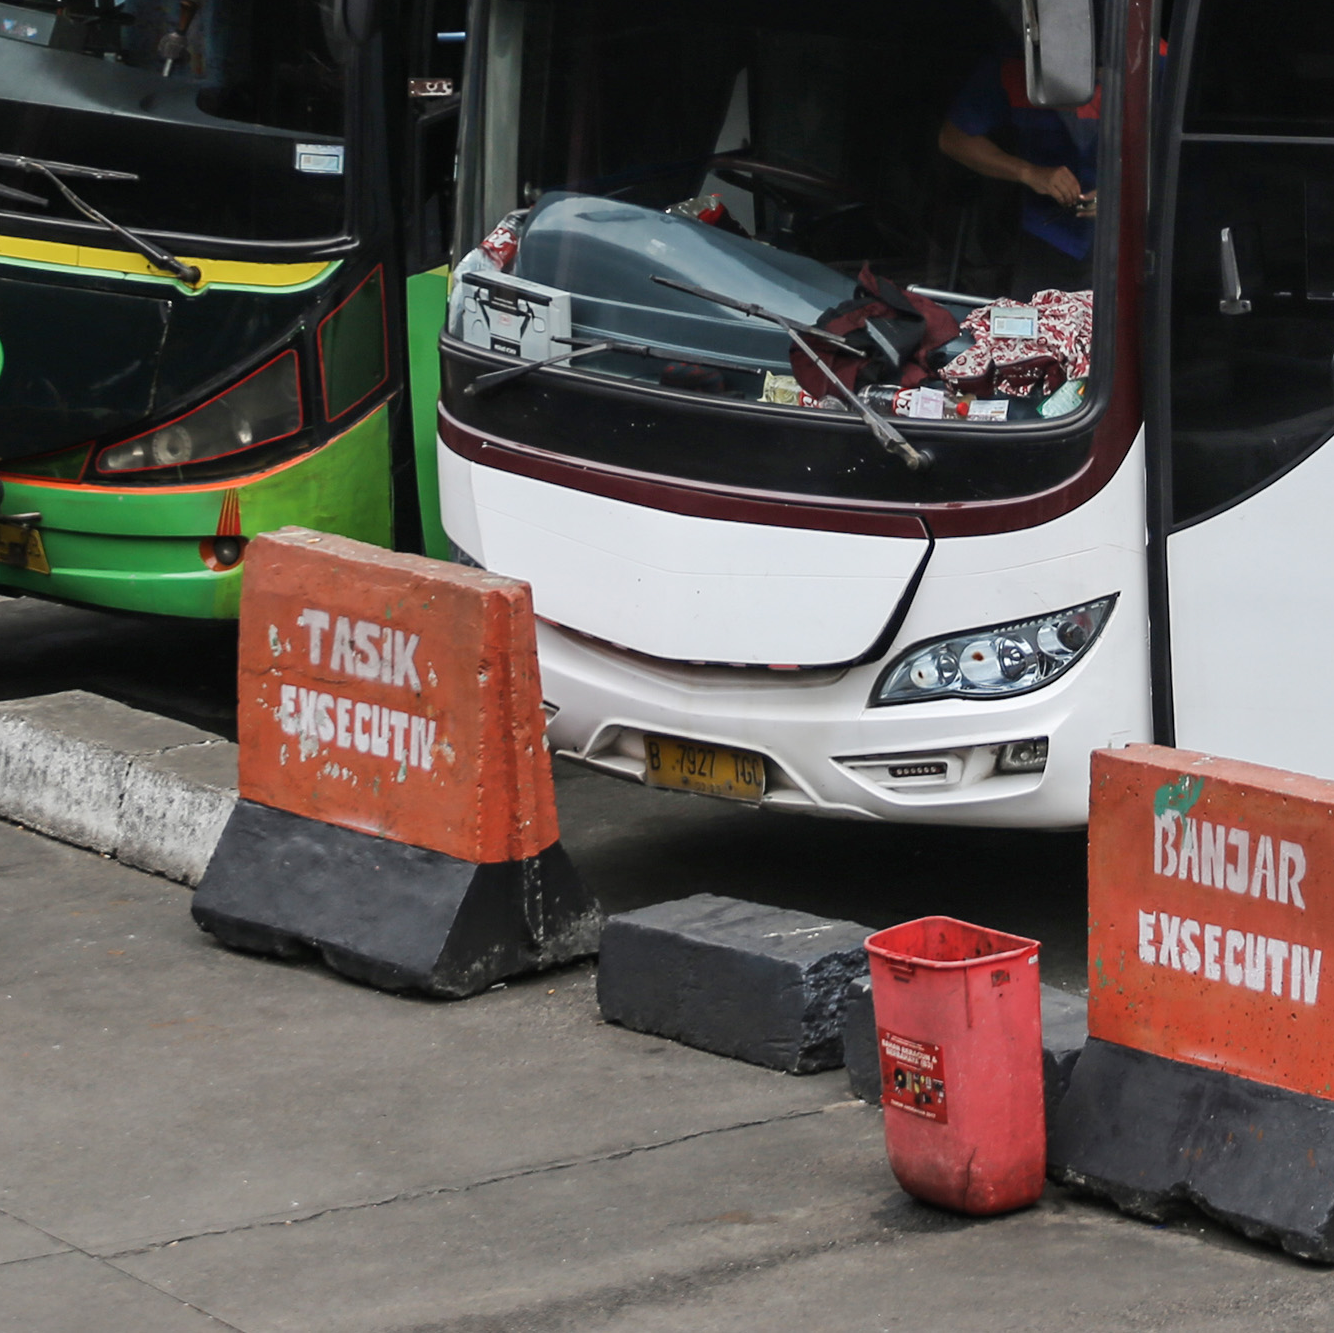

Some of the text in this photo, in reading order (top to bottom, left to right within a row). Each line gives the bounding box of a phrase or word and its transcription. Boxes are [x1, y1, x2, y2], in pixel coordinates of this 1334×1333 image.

[303, 608, 422, 691] TASIK
[648, 741, 661, 771] B
[677, 744, 716, 779] 7927
[1153, 809, 1307, 910] BANJAR
